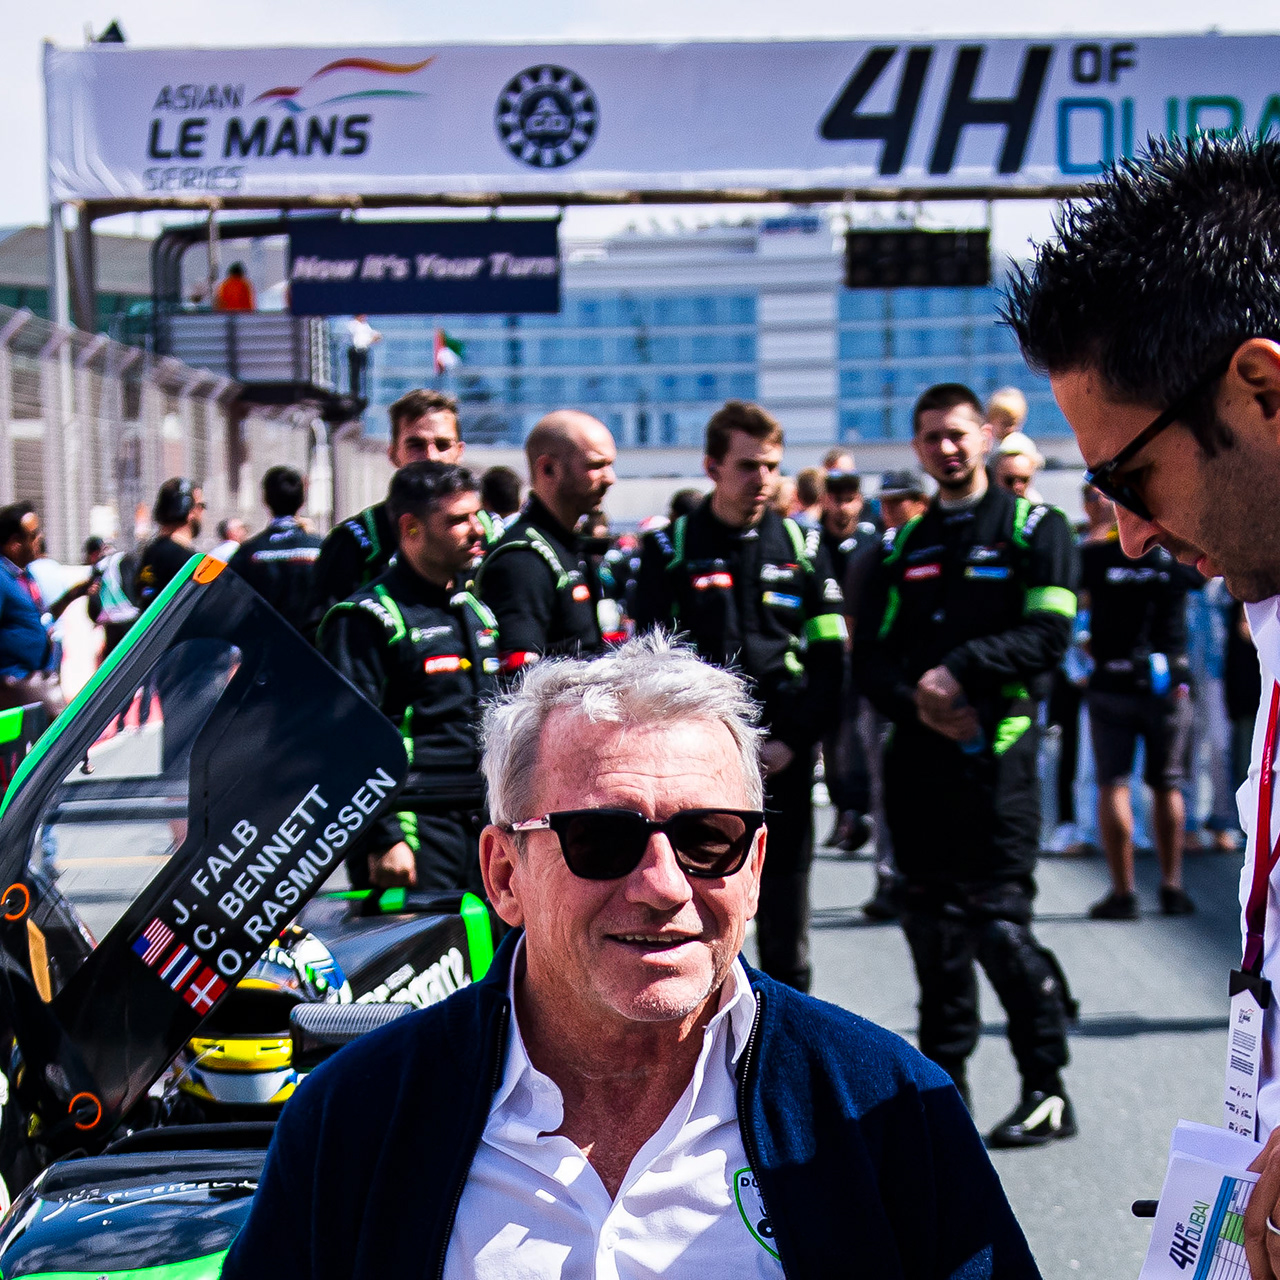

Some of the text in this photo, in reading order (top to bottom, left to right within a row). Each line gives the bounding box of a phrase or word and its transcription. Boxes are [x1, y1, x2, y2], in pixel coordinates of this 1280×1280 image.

[1070, 42, 1137, 84] OF
[152, 83, 244, 112] ASIAN
[817, 44, 1054, 176] 4H
[147, 113, 373, 160] LE MANS
[143, 165, 245, 191] SERIES
[172, 819, 259, 925] J. FALB
[193, 784, 329, 950] C. BENNETT
[217, 767, 397, 976] O. RASMUSSEN
[1175, 1221, 1185, 1233] OF
[1184, 1200, 1211, 1242] DUBAI
[1168, 1231, 1199, 1270] 4H
